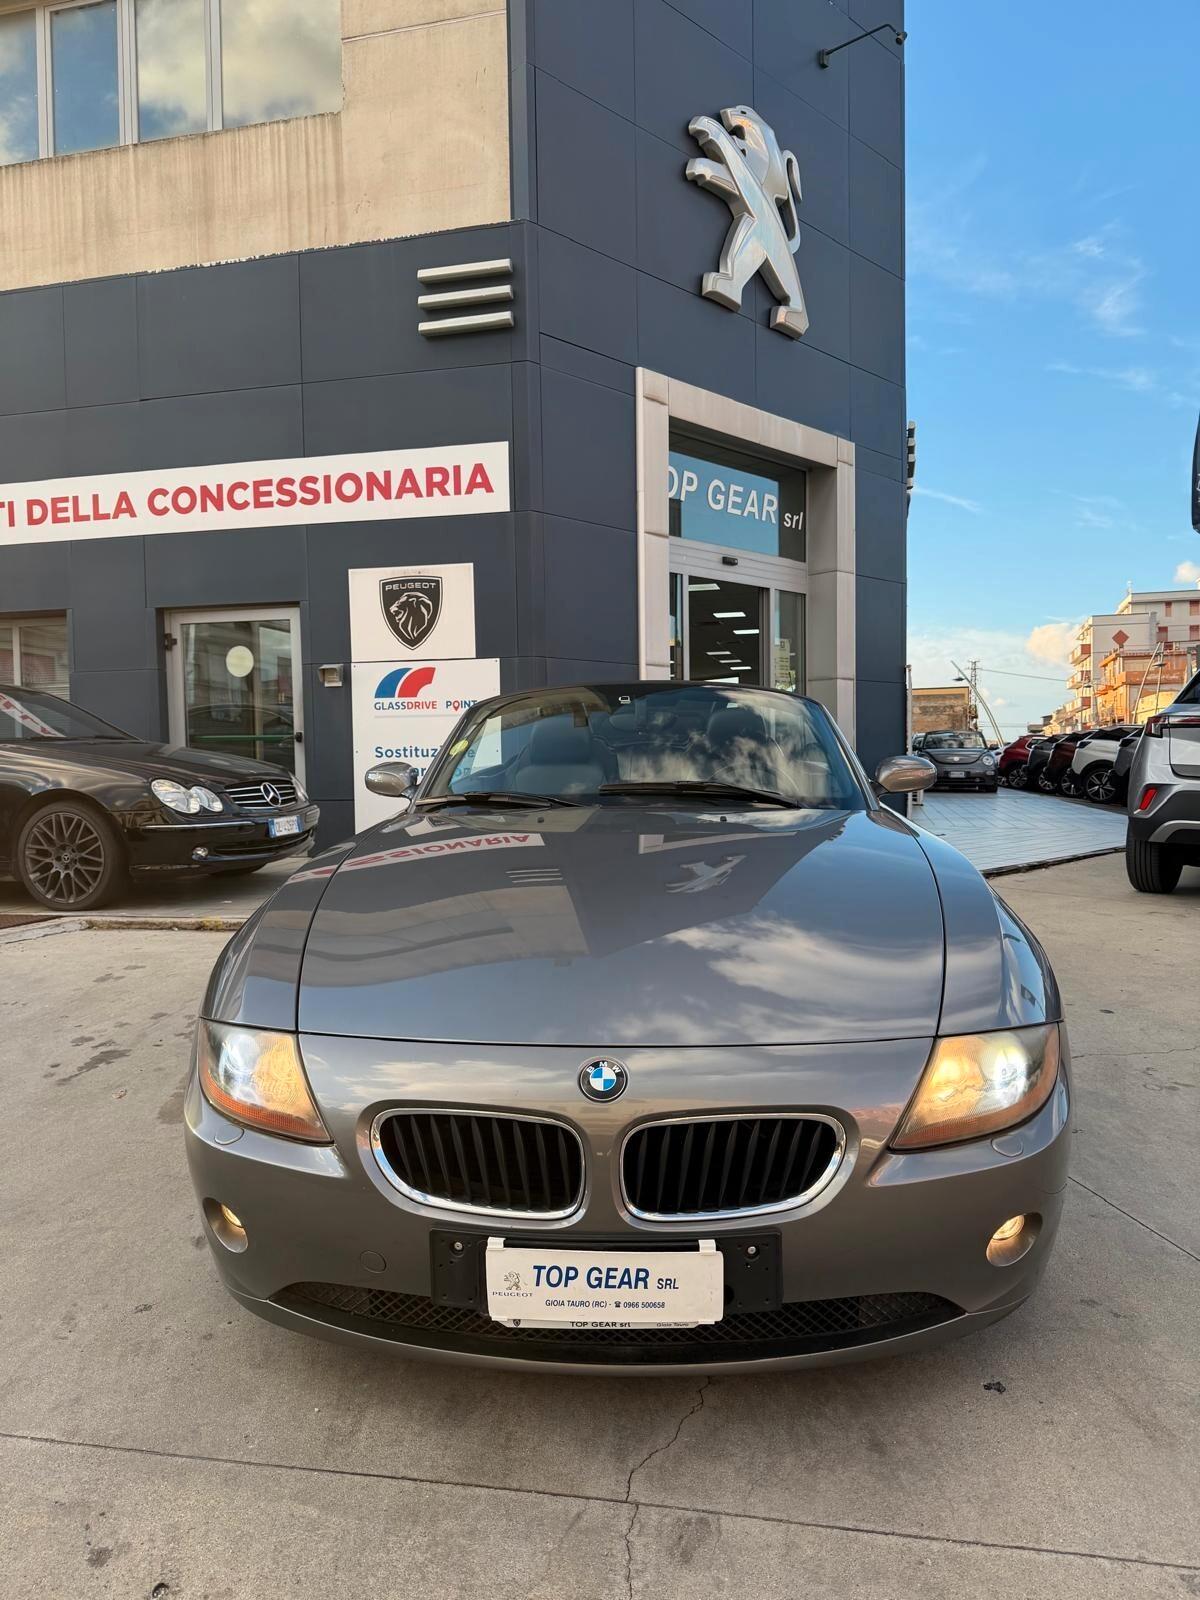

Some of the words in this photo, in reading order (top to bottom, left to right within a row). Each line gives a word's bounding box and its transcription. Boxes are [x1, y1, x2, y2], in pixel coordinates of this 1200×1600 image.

[0, 500, 16, 528] I
[26, 491, 137, 526] DELLA
[147, 463, 495, 517] CONCESSIONARIA
[707, 479, 779, 524] GEAR
[783, 511, 804, 531] srl
[385, 582, 437, 591] PEUGEOT
[374, 701, 437, 711] GLASSDRIVE
[375, 746, 441, 758] Sostituz
[586, 1061, 621, 1074] BMW
[533, 1265, 579, 1288] TOP
[586, 1266, 650, 1290] GEAR
[656, 1278, 679, 1290] SRL
[545, 1299, 565, 1307] GIOIA
[567, 1300, 590, 1308] TAURO
[592, 1301, 607, 1309] (RC)
